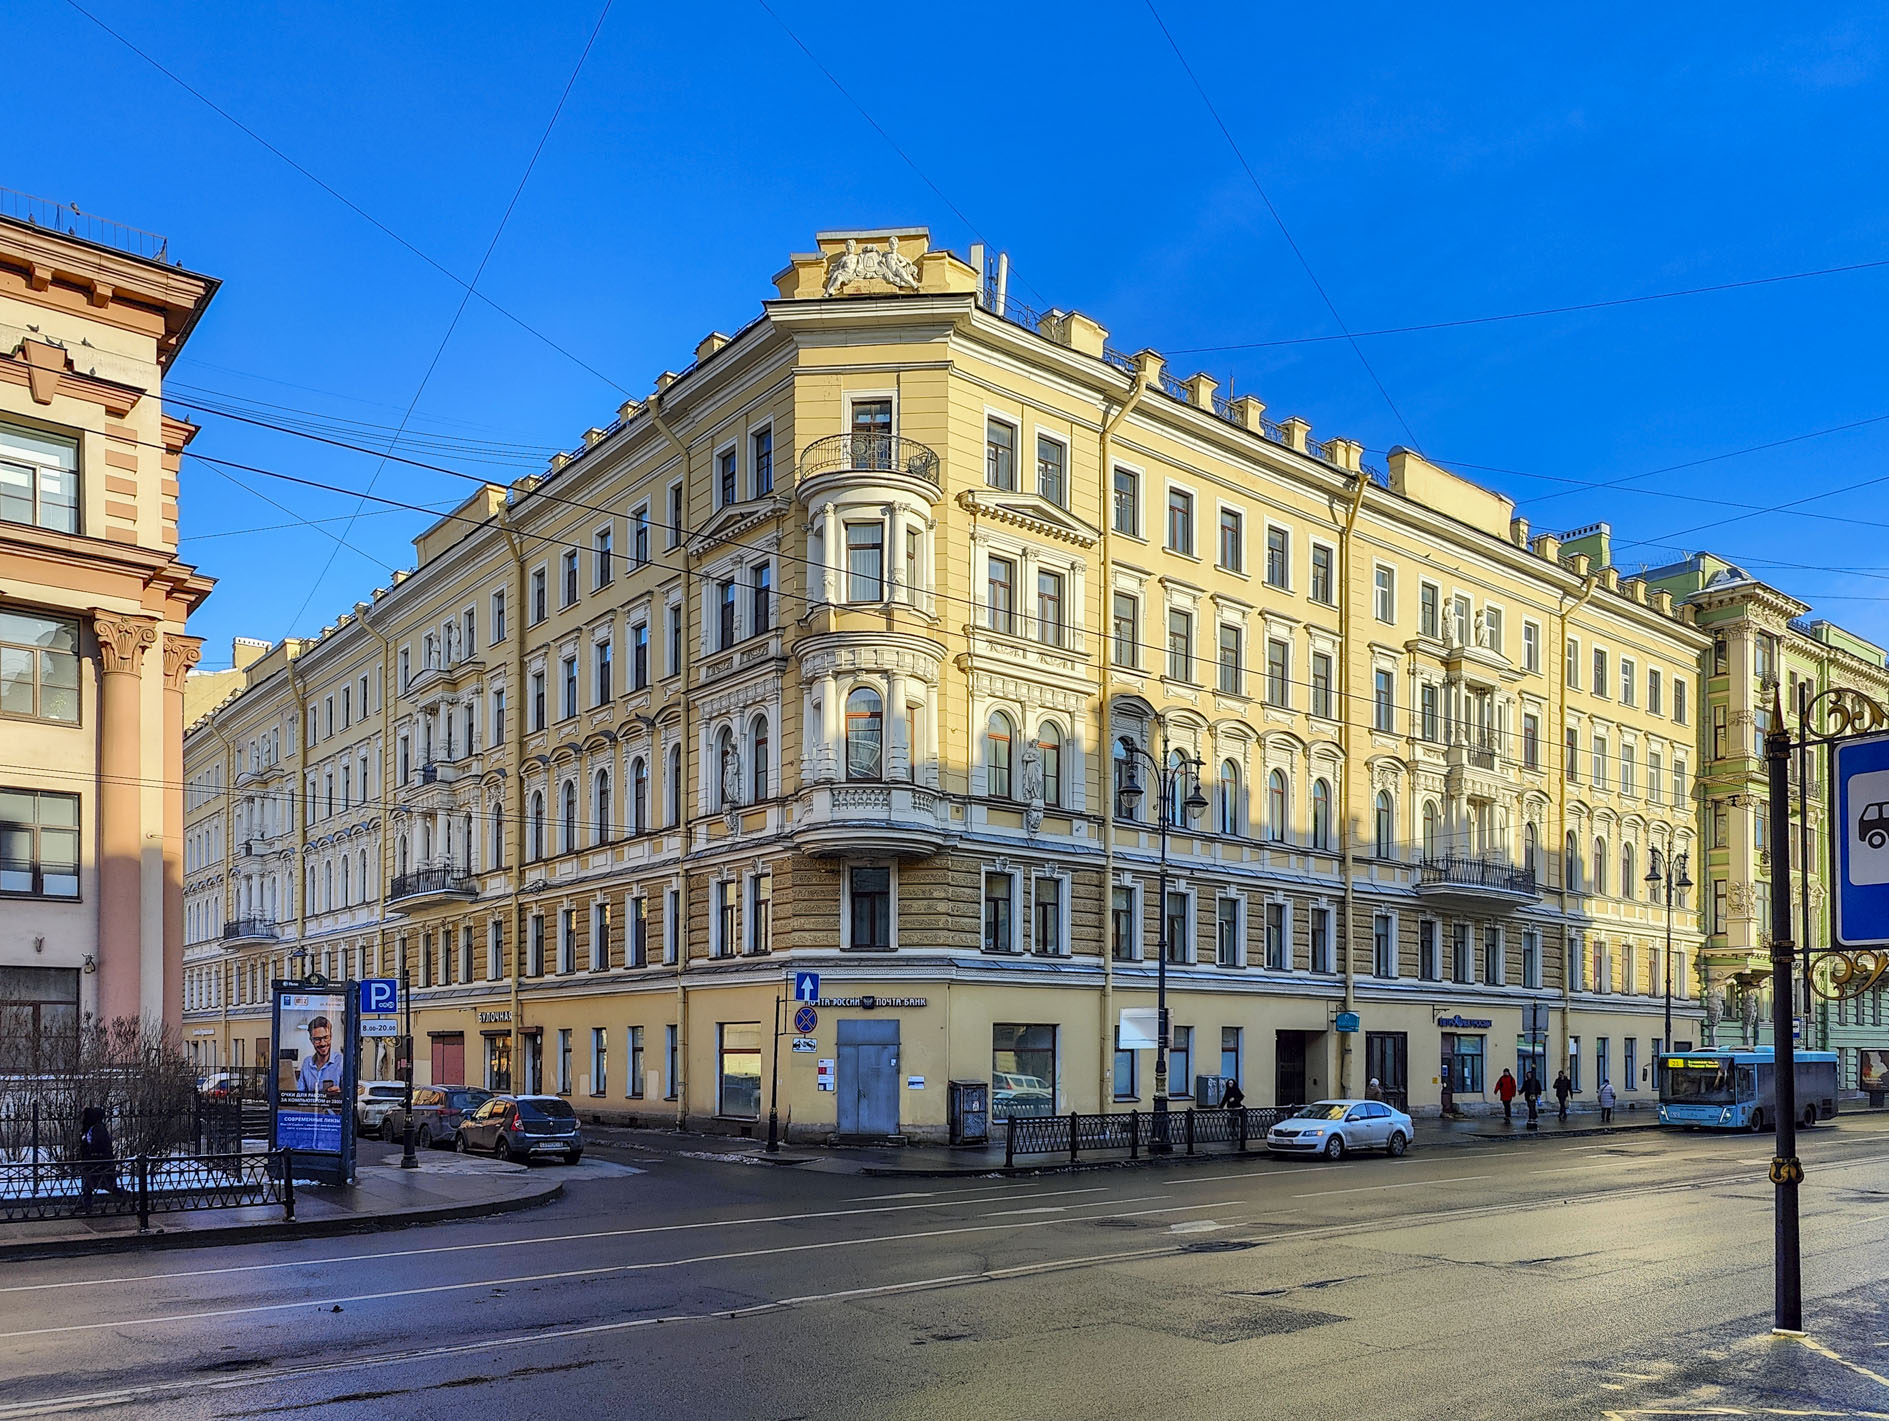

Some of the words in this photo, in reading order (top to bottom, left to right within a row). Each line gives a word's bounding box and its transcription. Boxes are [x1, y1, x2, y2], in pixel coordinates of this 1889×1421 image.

[371, 983, 390, 1010] P
[833, 998, 861, 1007] РОССИИ
[876, 998, 902, 1006] ПОЧТА
[904, 998, 926, 1006] БАНК
[479, 1011, 512, 1023] БУЛОЧНАЯ
